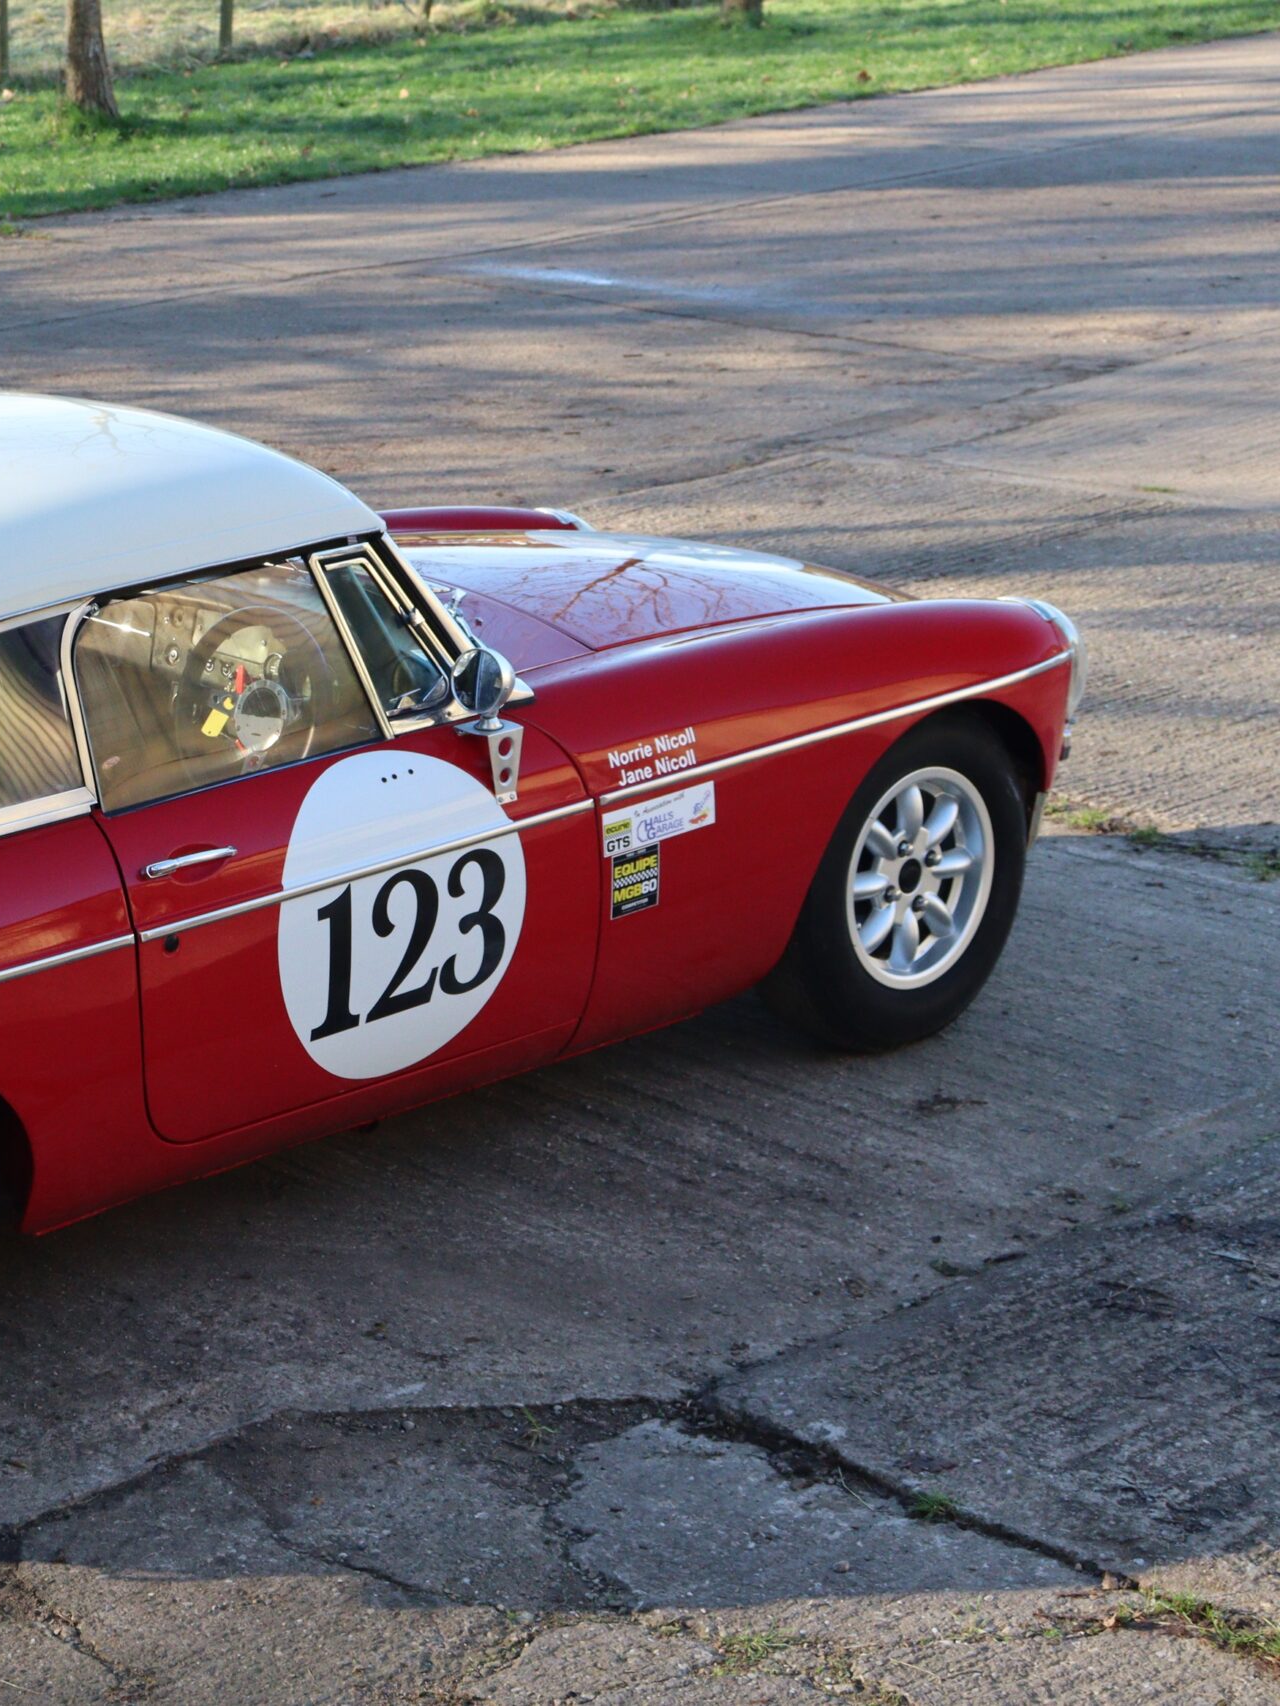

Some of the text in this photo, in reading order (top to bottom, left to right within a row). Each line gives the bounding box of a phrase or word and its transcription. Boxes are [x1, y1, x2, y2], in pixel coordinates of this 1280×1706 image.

[608, 727, 696, 768] Norrie Nicoll
[619, 749, 696, 786] Jane Nicoll
[606, 835, 631, 853] GTS
[614, 854, 658, 879] EQUIPE
[614, 878, 658, 904] MGB60
[310, 848, 506, 1042] 123
